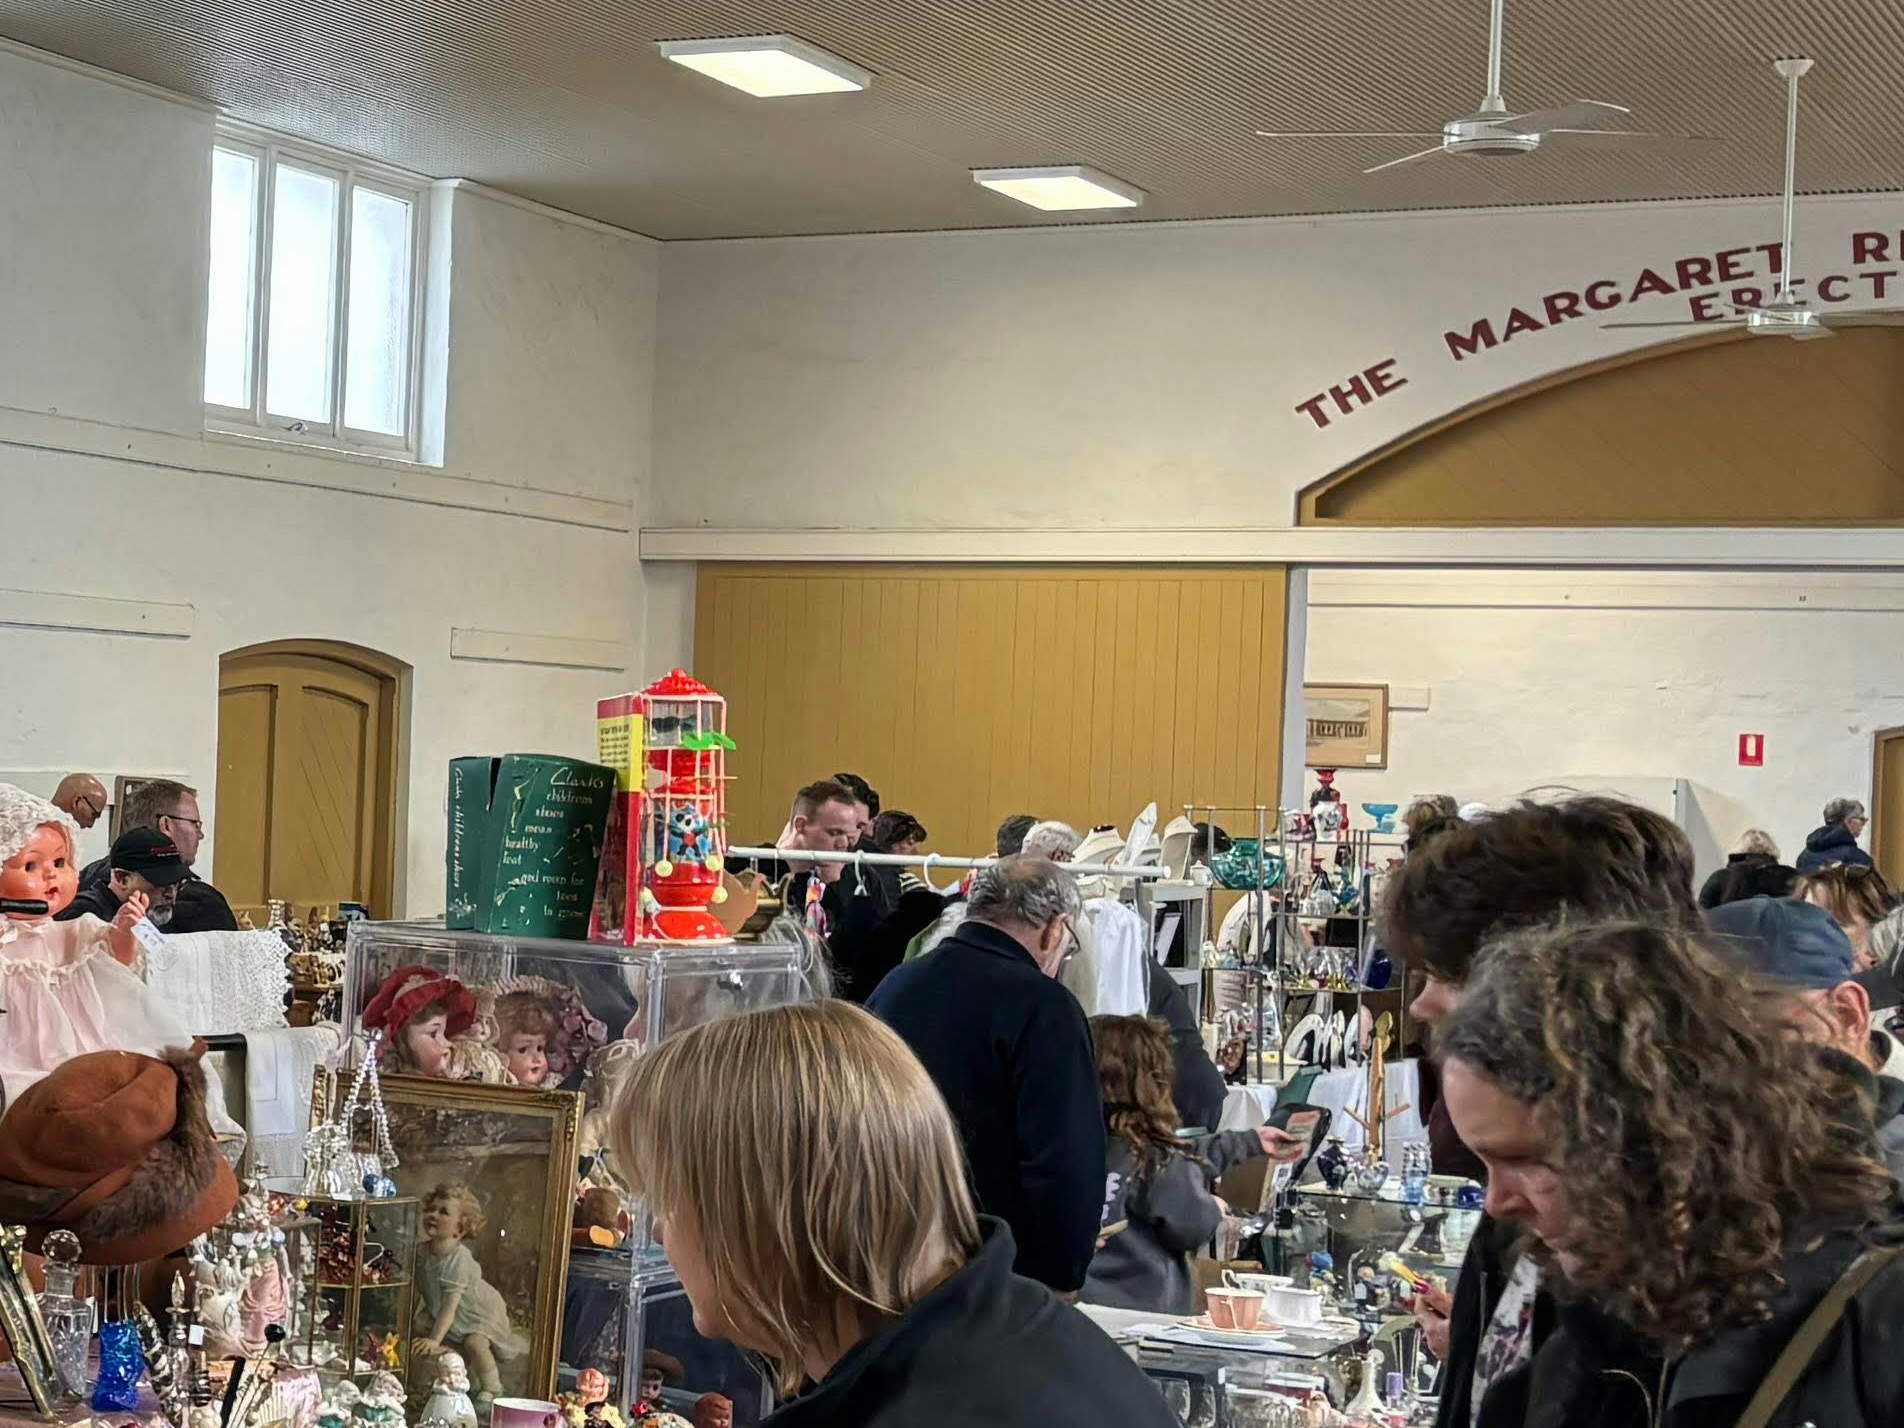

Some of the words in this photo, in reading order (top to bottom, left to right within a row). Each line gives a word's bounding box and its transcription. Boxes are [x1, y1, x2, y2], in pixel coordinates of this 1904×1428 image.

[1295, 357, 1408, 429] THE
[1443, 242, 1793, 361] MARGARET
[550, 766, 606, 789] Clarks
[505, 835, 541, 853] healthy
